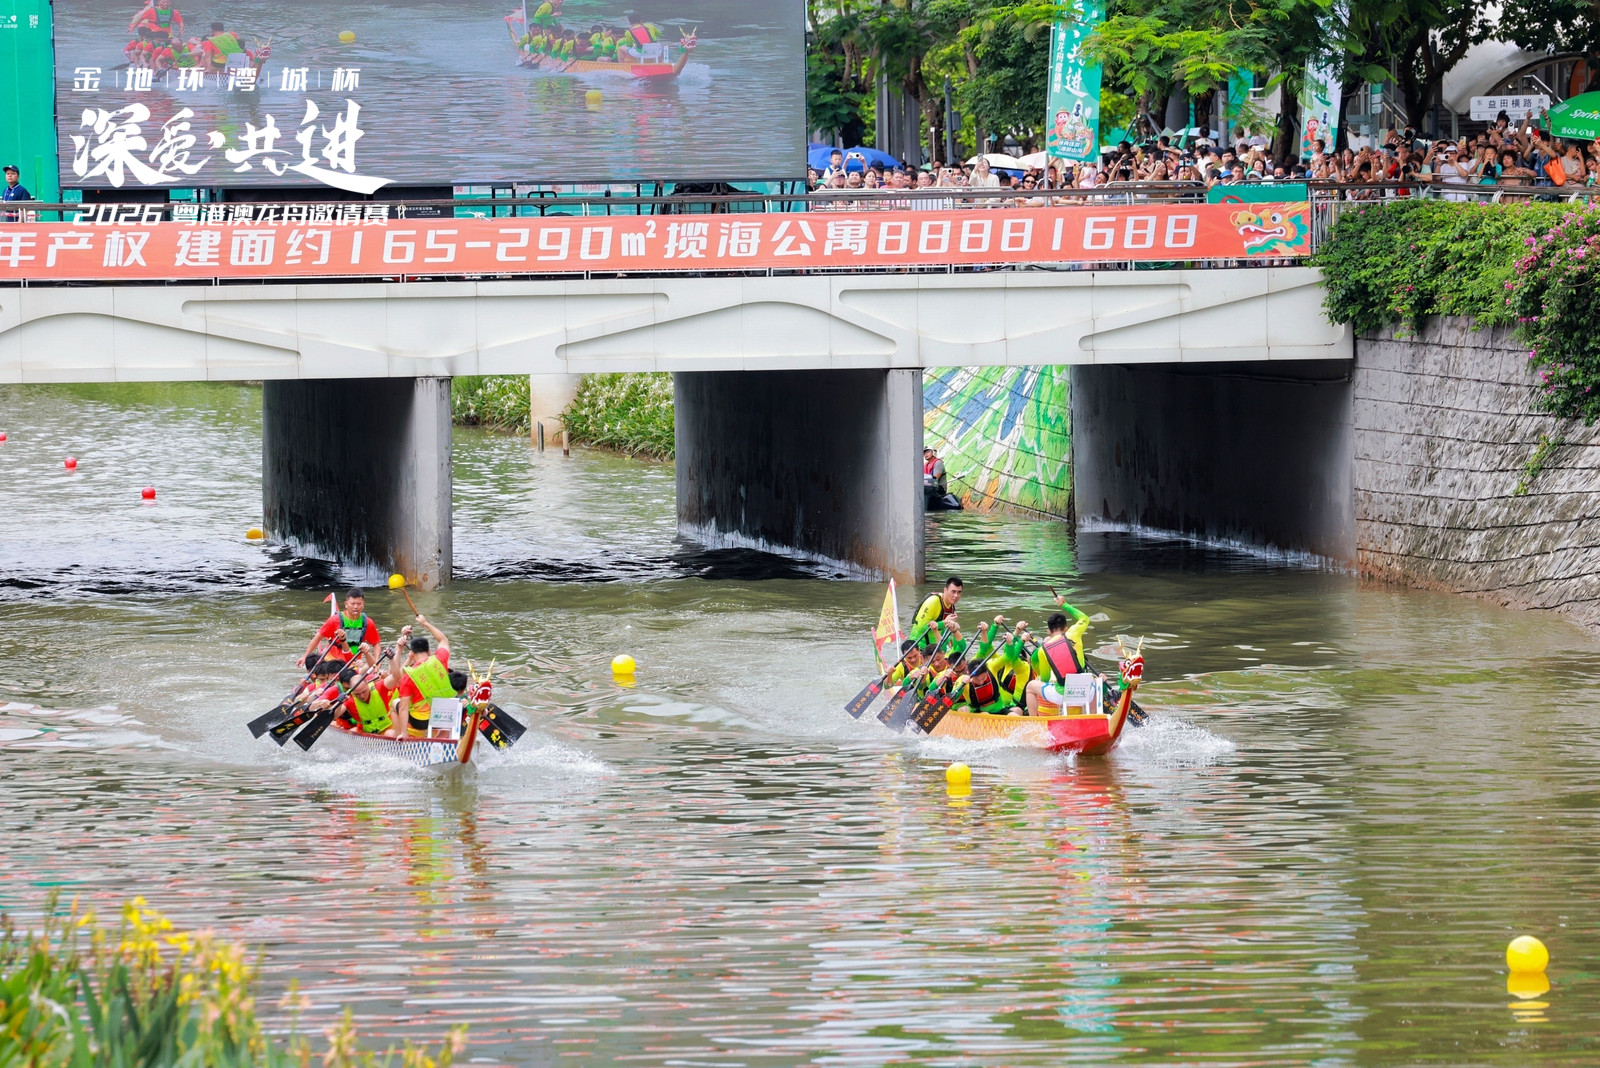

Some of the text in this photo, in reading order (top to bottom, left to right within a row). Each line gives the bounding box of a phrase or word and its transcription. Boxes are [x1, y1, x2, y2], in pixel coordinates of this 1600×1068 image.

[1488, 98, 1532, 109] 益田横路
[0, 230, 151, 267] 年产权
